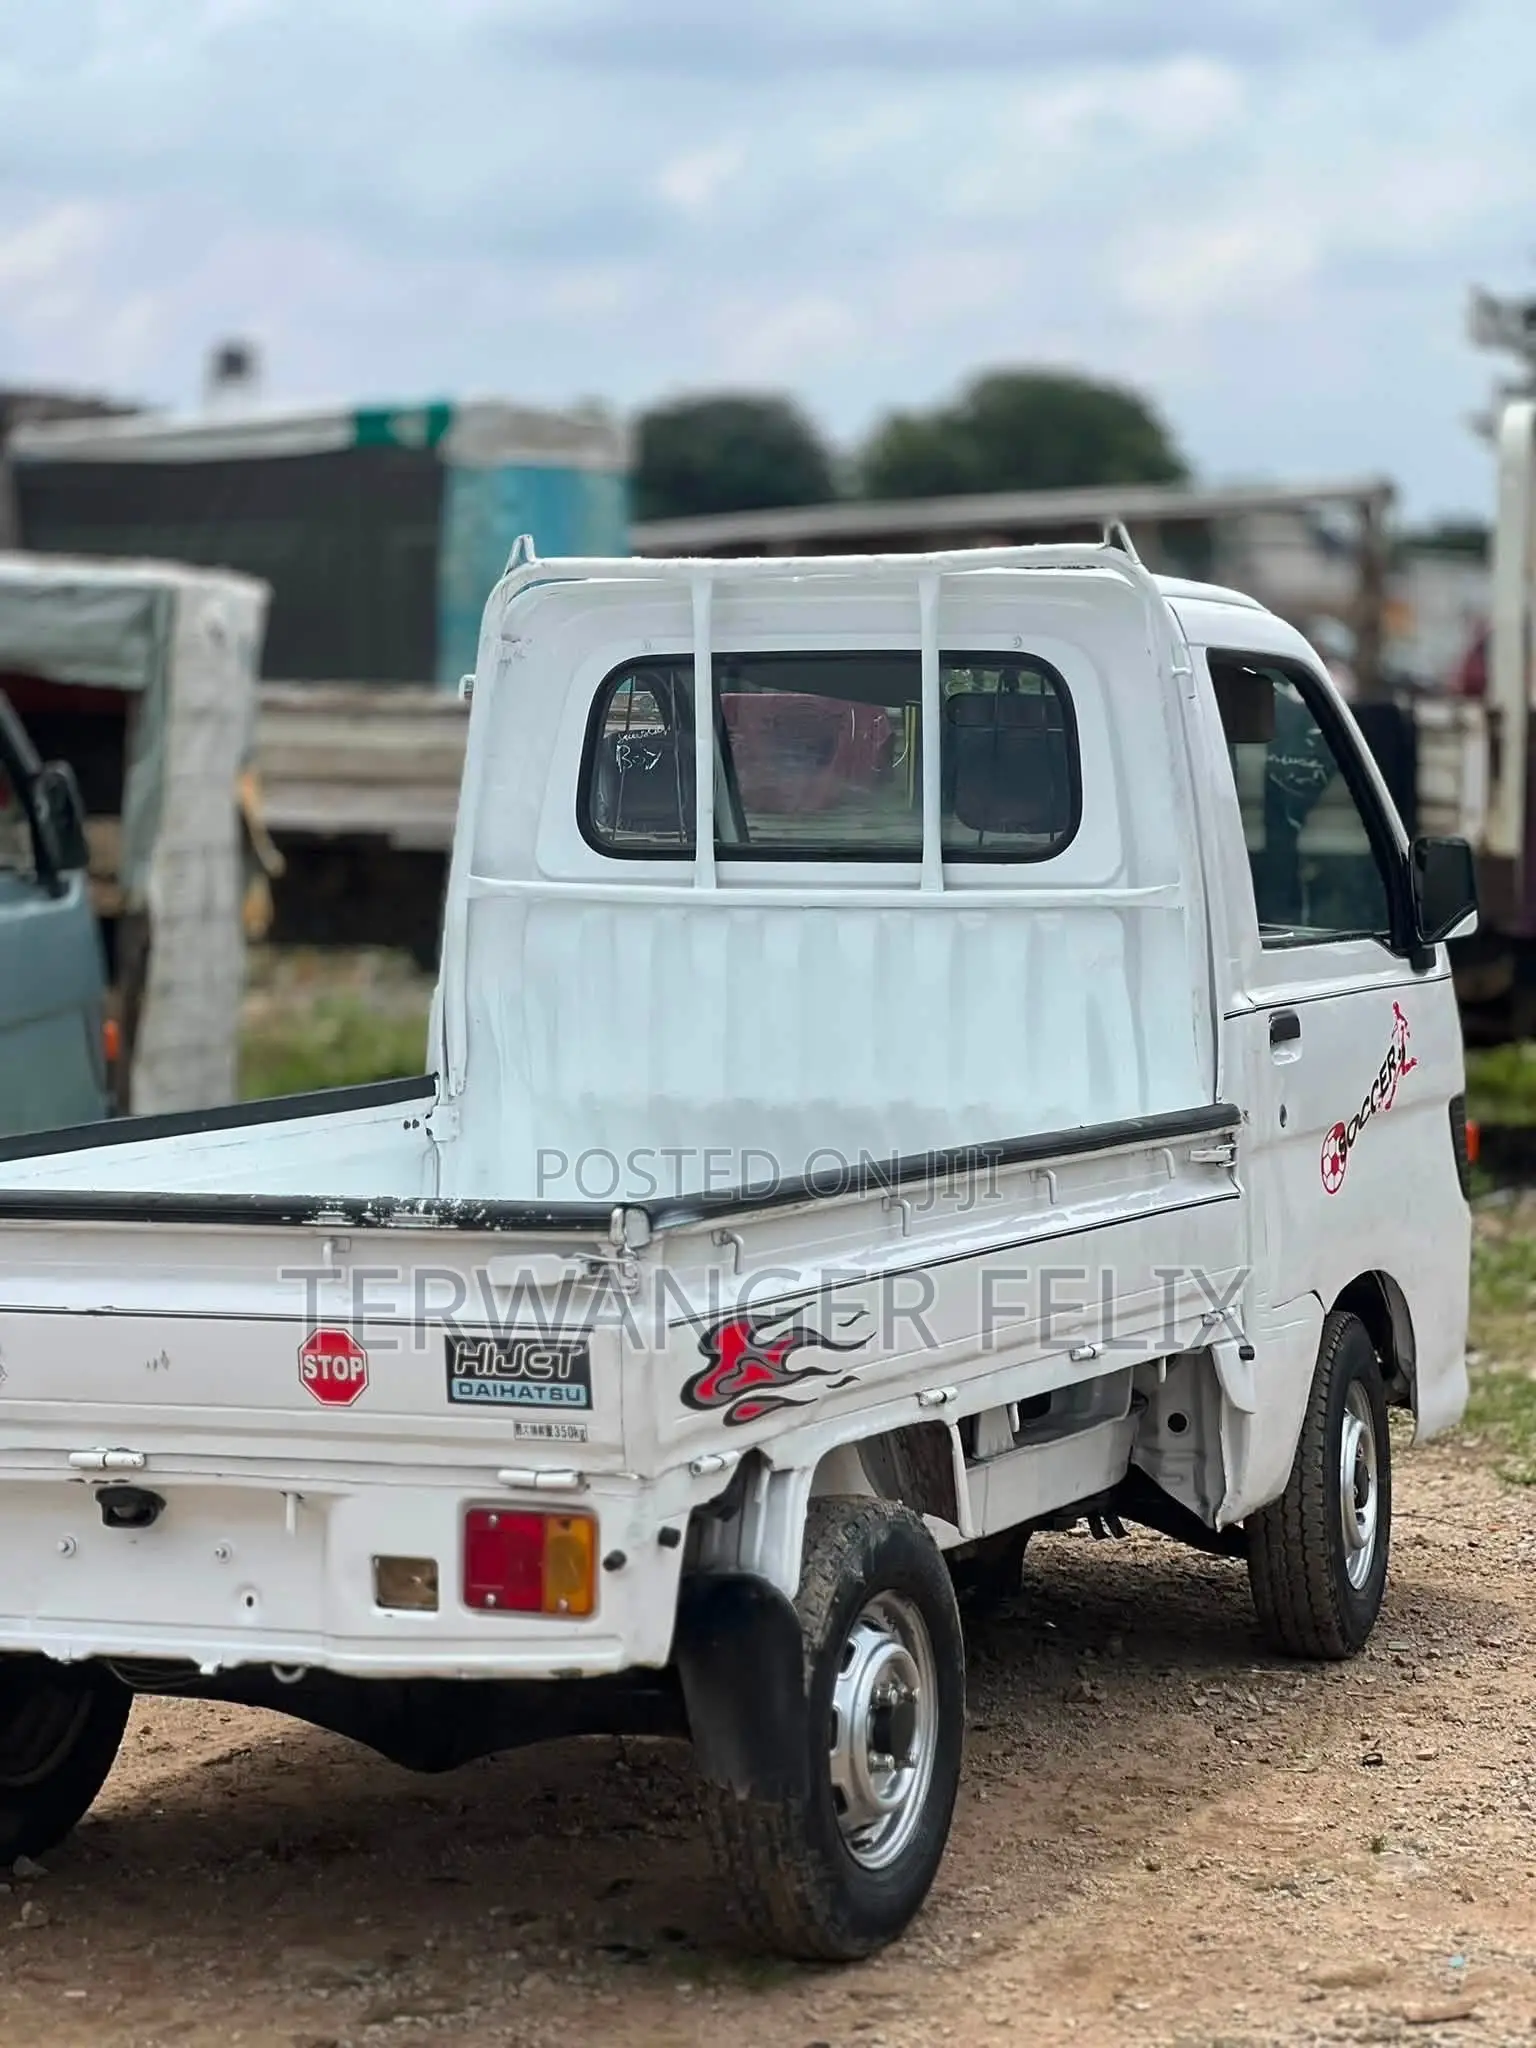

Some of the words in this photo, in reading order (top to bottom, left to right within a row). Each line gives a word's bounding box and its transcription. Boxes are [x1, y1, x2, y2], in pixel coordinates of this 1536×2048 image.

[1337, 1045, 1397, 1163] SOCCER
[303, 1354, 363, 1381] STOP
[458, 1382, 581, 1401] DAIHATSU
